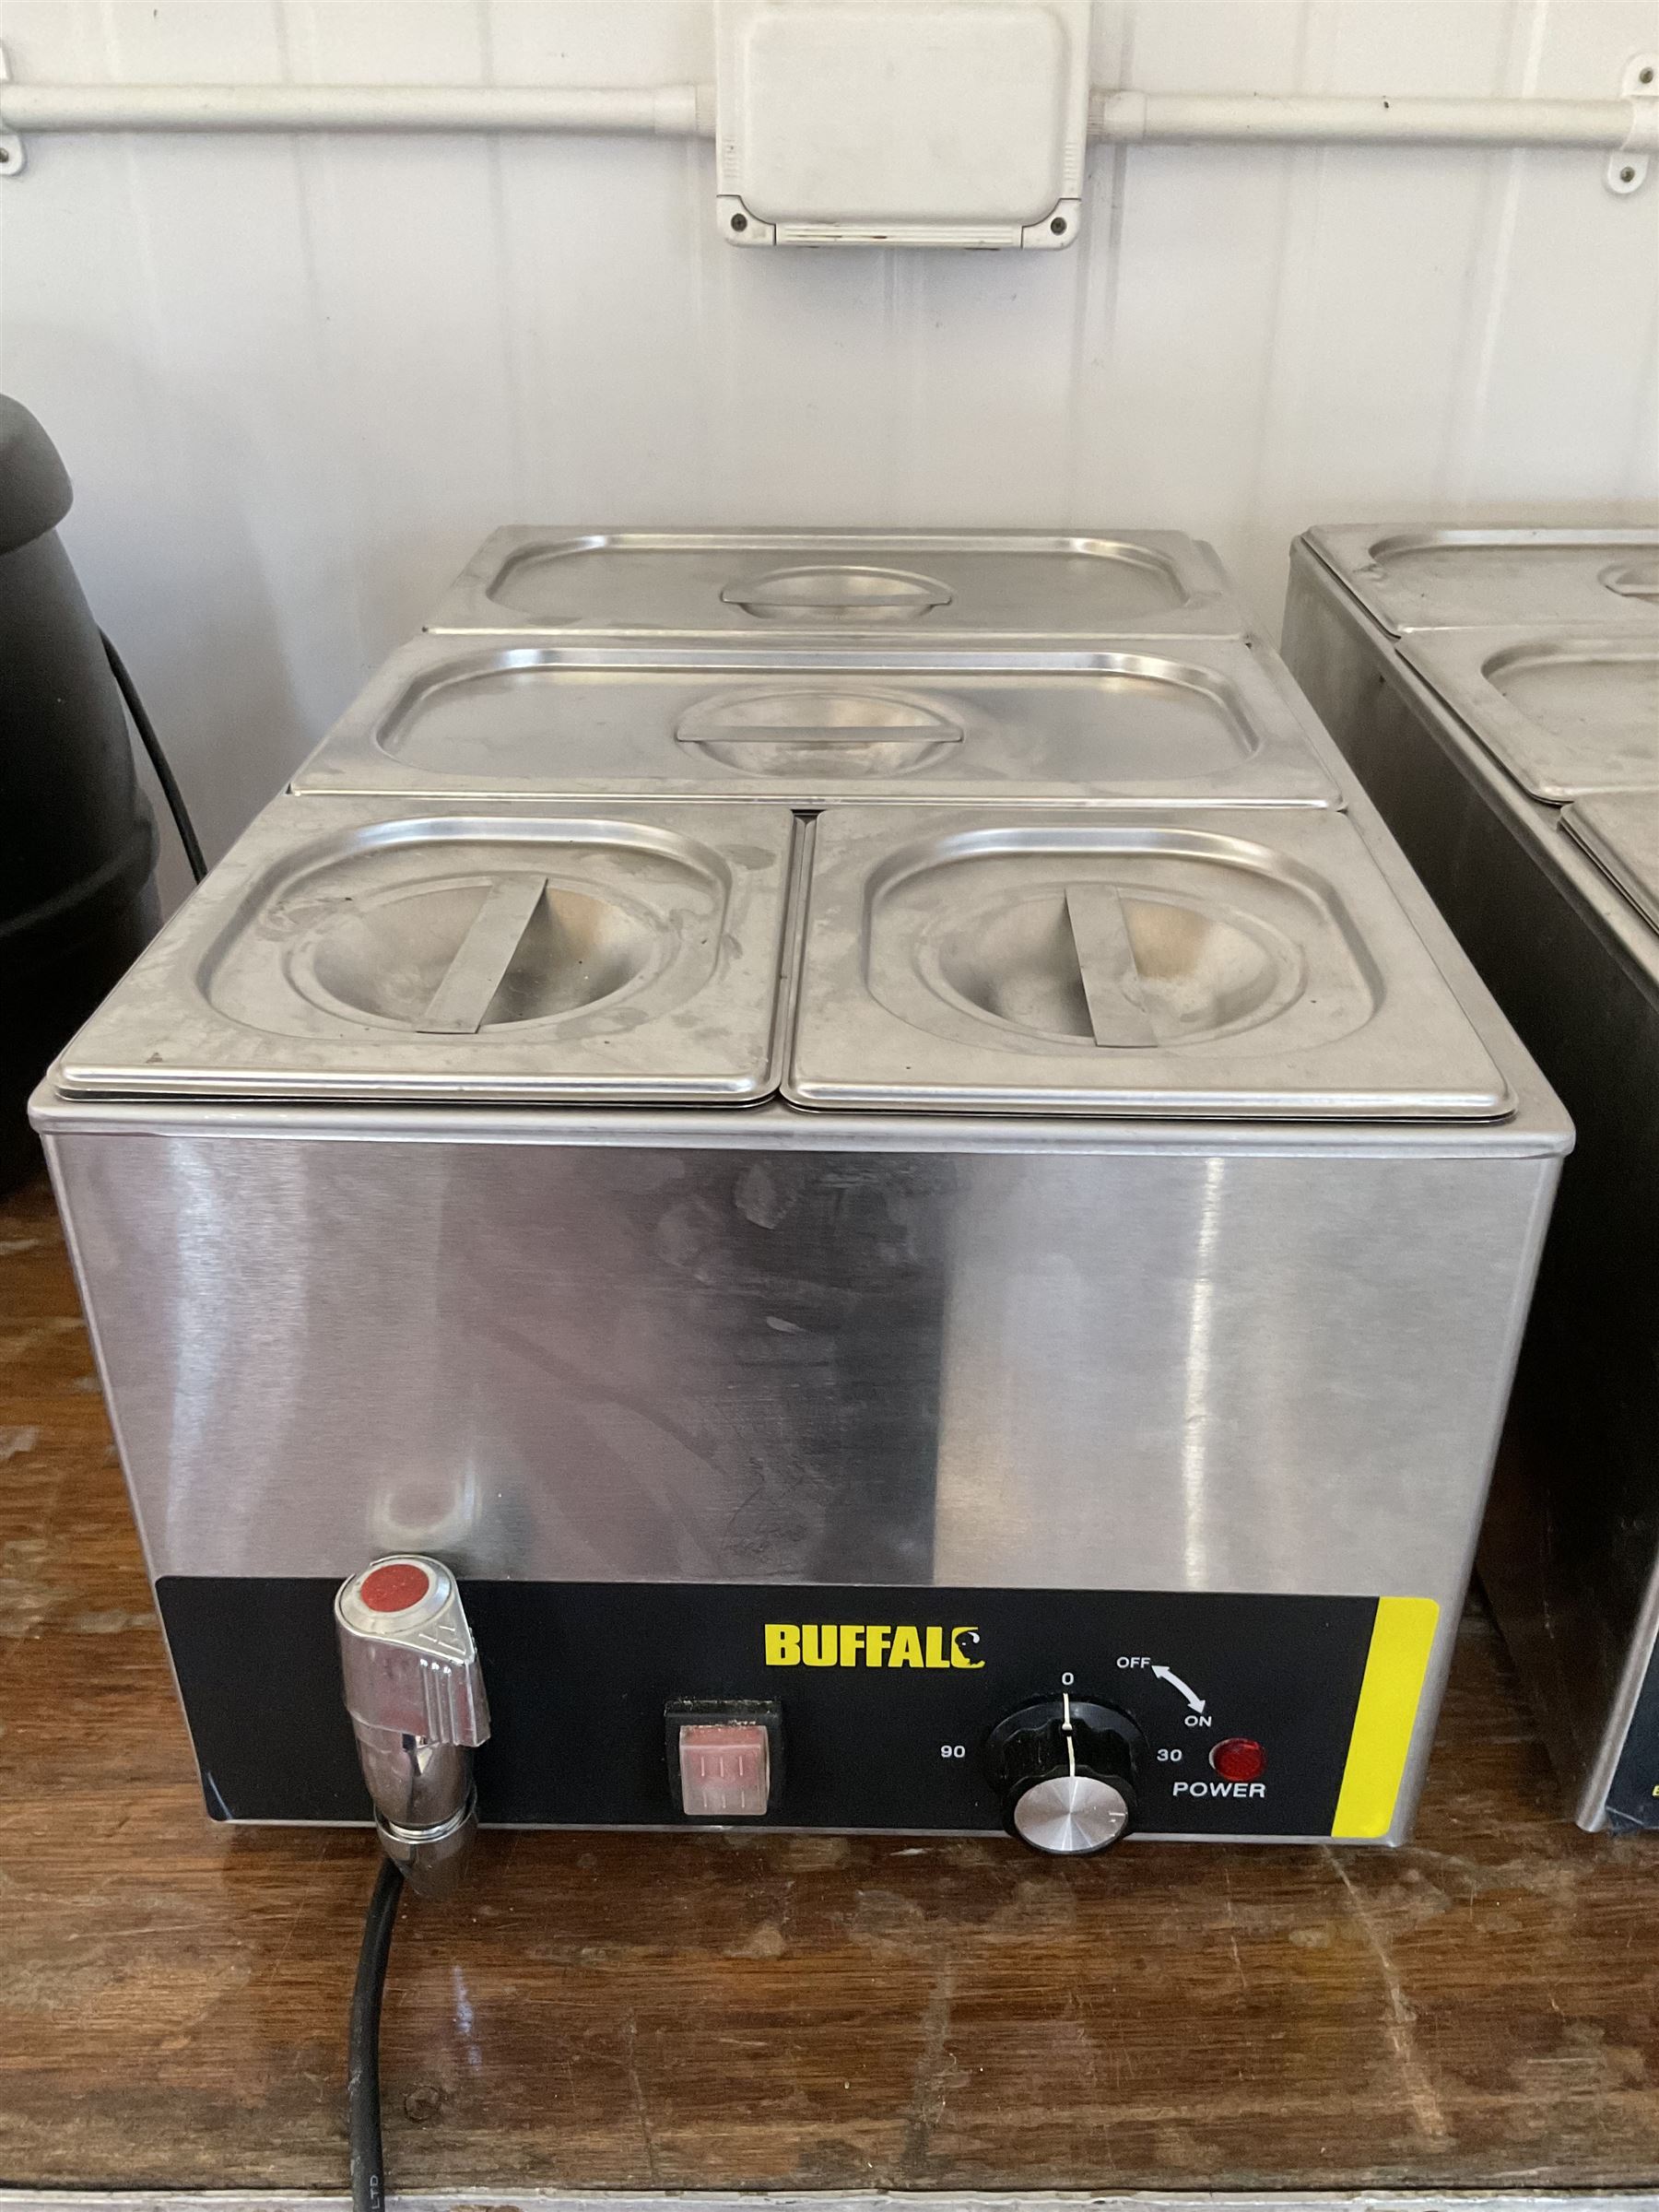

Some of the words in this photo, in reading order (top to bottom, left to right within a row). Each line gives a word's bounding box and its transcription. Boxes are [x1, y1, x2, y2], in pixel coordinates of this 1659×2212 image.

[1116, 1656, 1151, 1669] OFF
[1061, 1672, 1075, 1686] 0
[1184, 1715, 1212, 1728] ON
[940, 1745, 966, 1759] 90
[1157, 1748, 1182, 1762] 30
[1172, 1782, 1266, 1798] POWER
[370, 2174, 380, 2209] LTD
